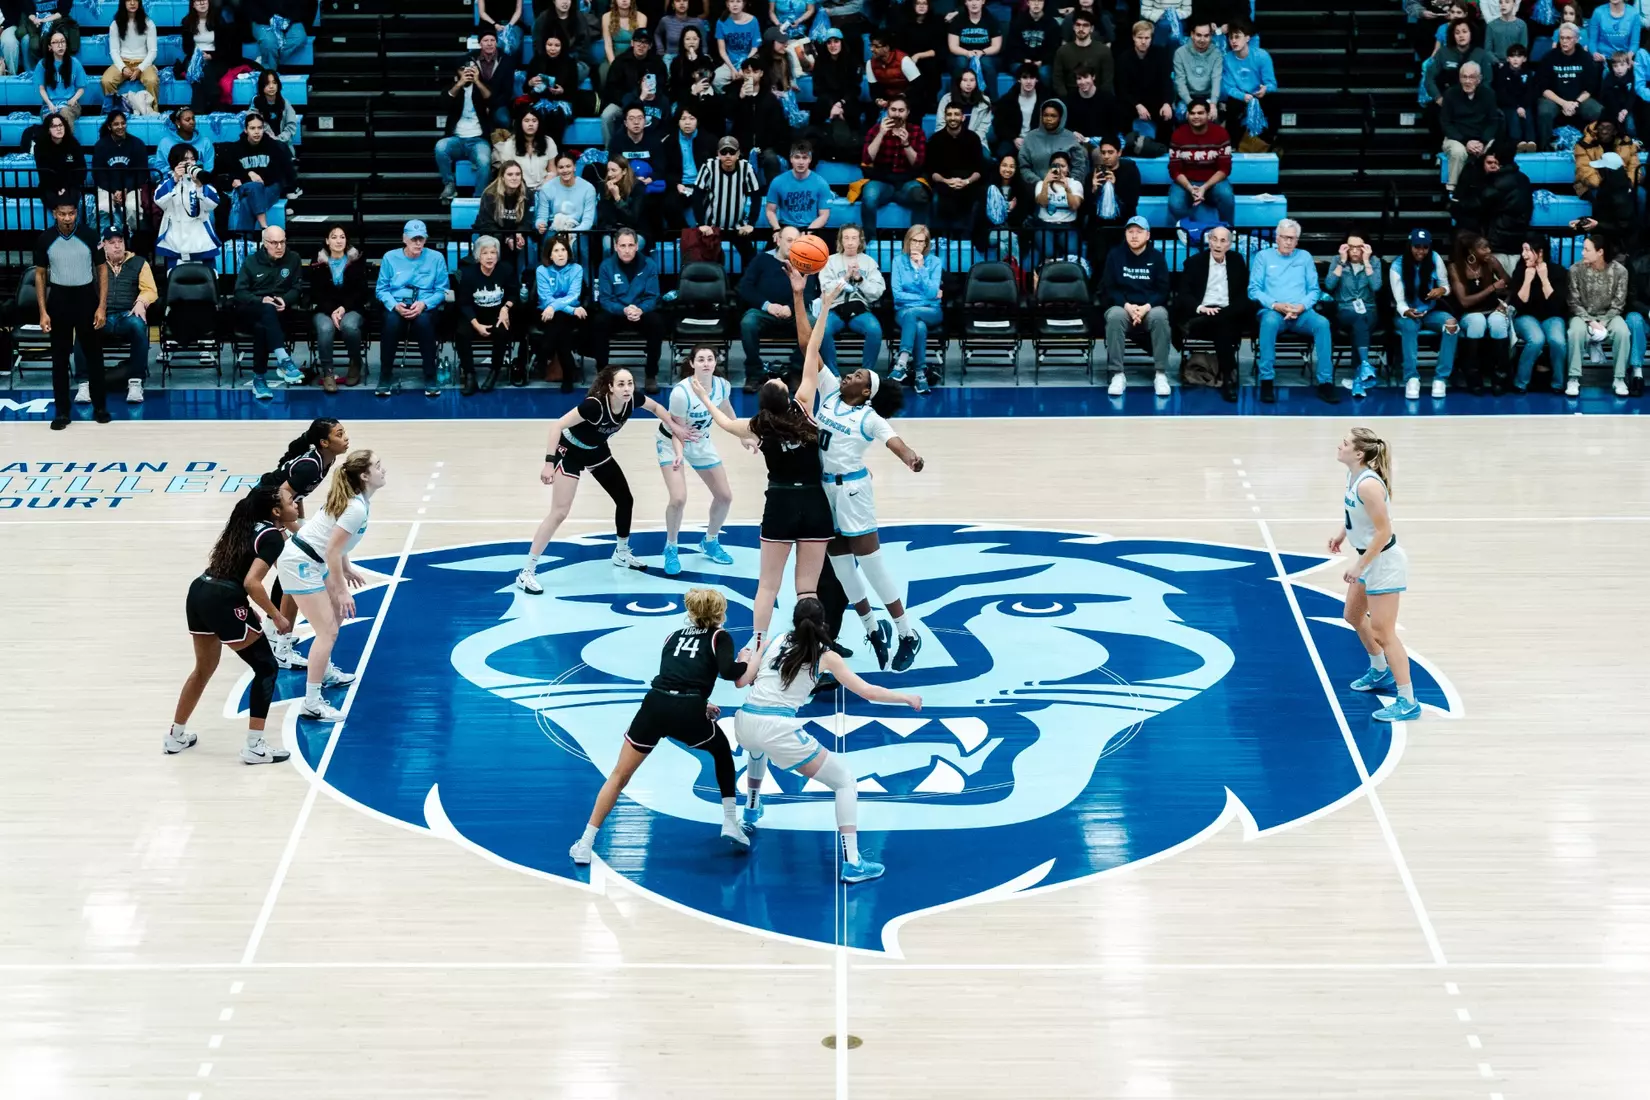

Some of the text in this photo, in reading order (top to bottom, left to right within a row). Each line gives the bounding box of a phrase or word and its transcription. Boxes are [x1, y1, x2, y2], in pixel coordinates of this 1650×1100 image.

[787, 191, 812, 200] ROAR
[184, 461, 228, 473] D.
[673, 636, 700, 658] 14
